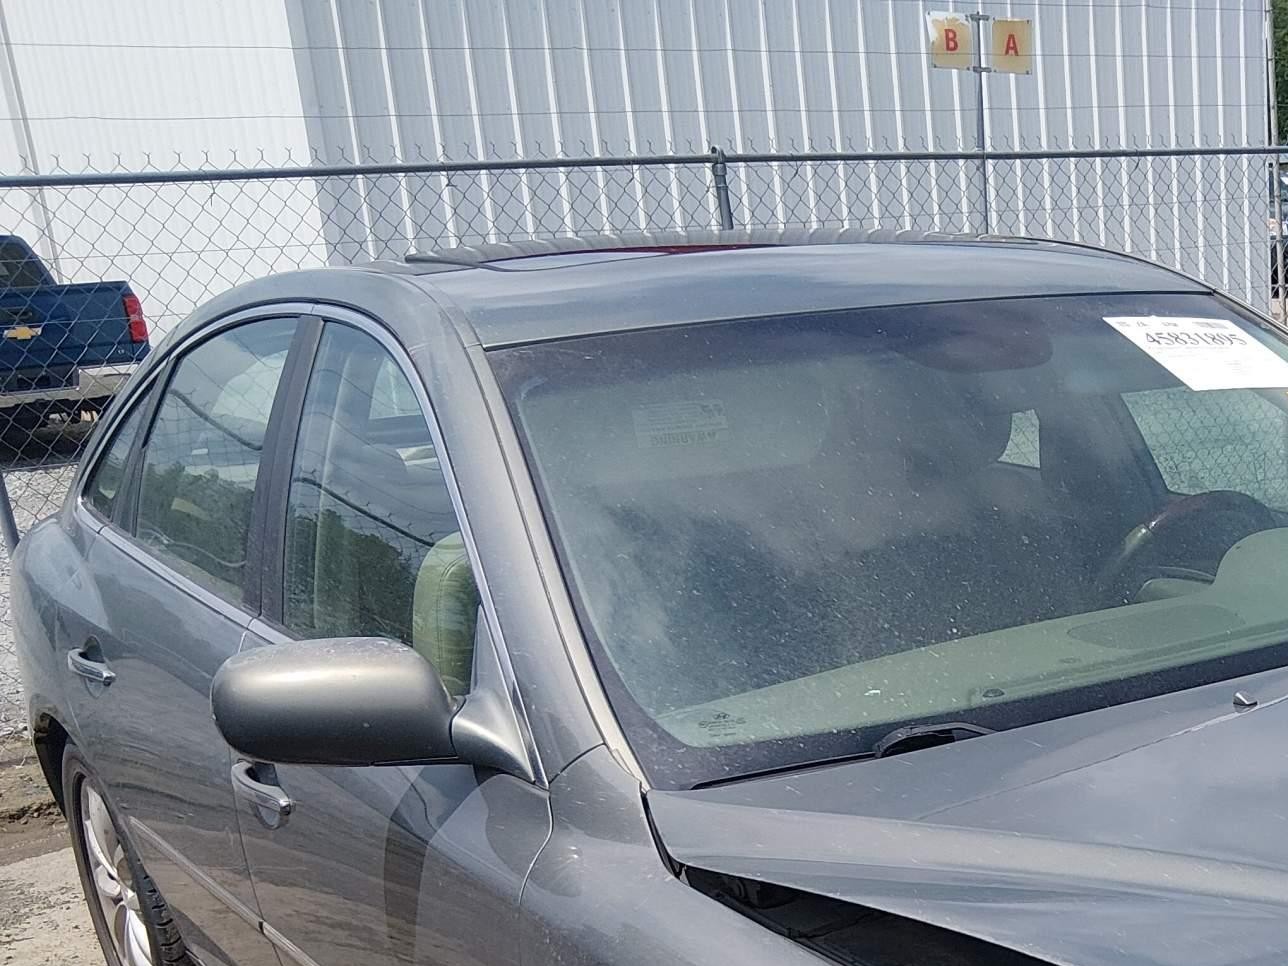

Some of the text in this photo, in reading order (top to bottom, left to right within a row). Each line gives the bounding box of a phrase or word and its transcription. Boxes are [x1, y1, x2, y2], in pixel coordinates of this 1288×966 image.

[944, 28, 958, 51] B
[1004, 33, 1019, 56] A
[1145, 331, 1248, 346] 45831895
